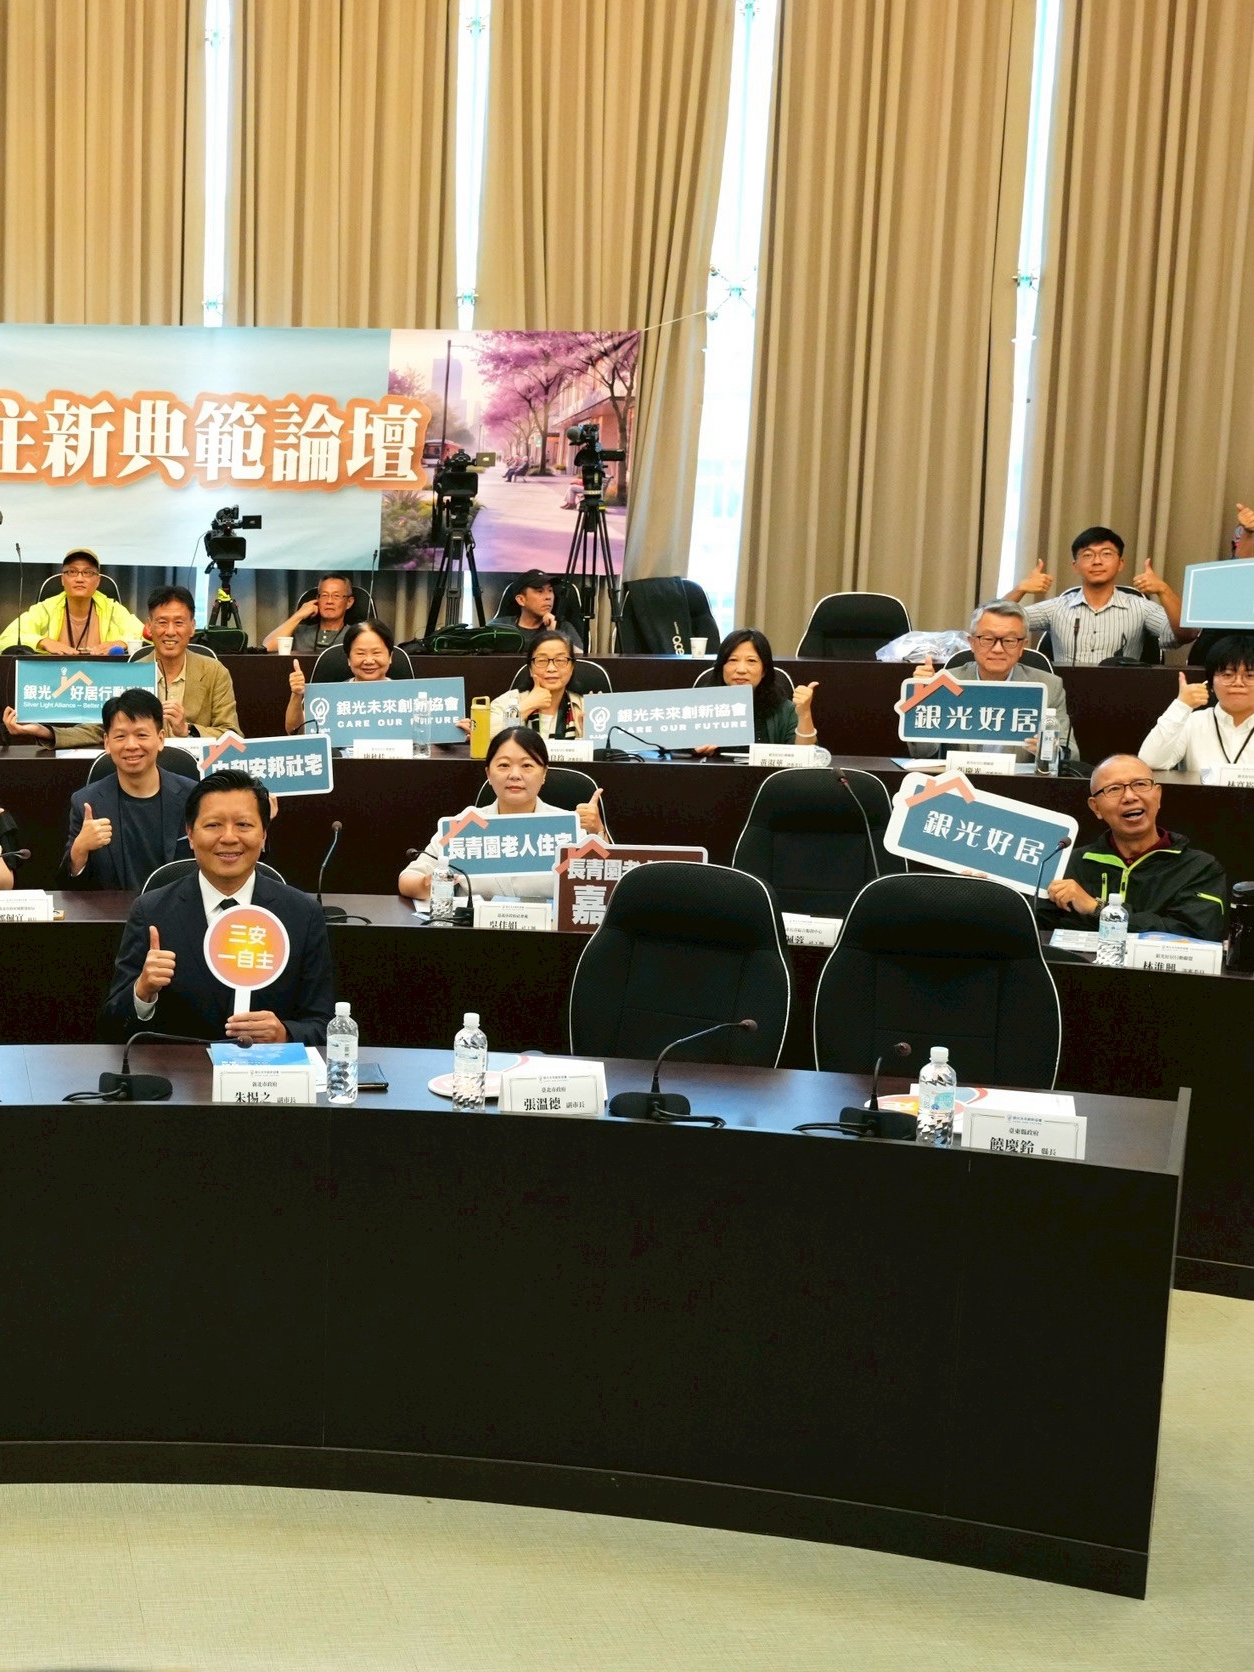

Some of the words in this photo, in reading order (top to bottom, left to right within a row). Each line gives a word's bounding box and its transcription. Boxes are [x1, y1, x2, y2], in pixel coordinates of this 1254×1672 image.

[23, 685, 52, 700] 銀光
[70, 685, 155, 701] 好居行動
[40, 701, 54, 709] Light
[336, 696, 459, 716] 銀光未來創新協會
[617, 702, 747, 723] 銀光未來創新協會
[337, 720, 371, 729] CARE
[378, 718, 402, 727] OUR
[660, 724, 687, 732] OUR
[695, 721, 747, 730] FUTURE
[914, 704, 1039, 733] 銀光好居
[922, 810, 1045, 867] 銀光好居
[572, 885, 607, 925] 嘉
[228, 923, 266, 946] 三安
[218, 949, 274, 970] 一自主
